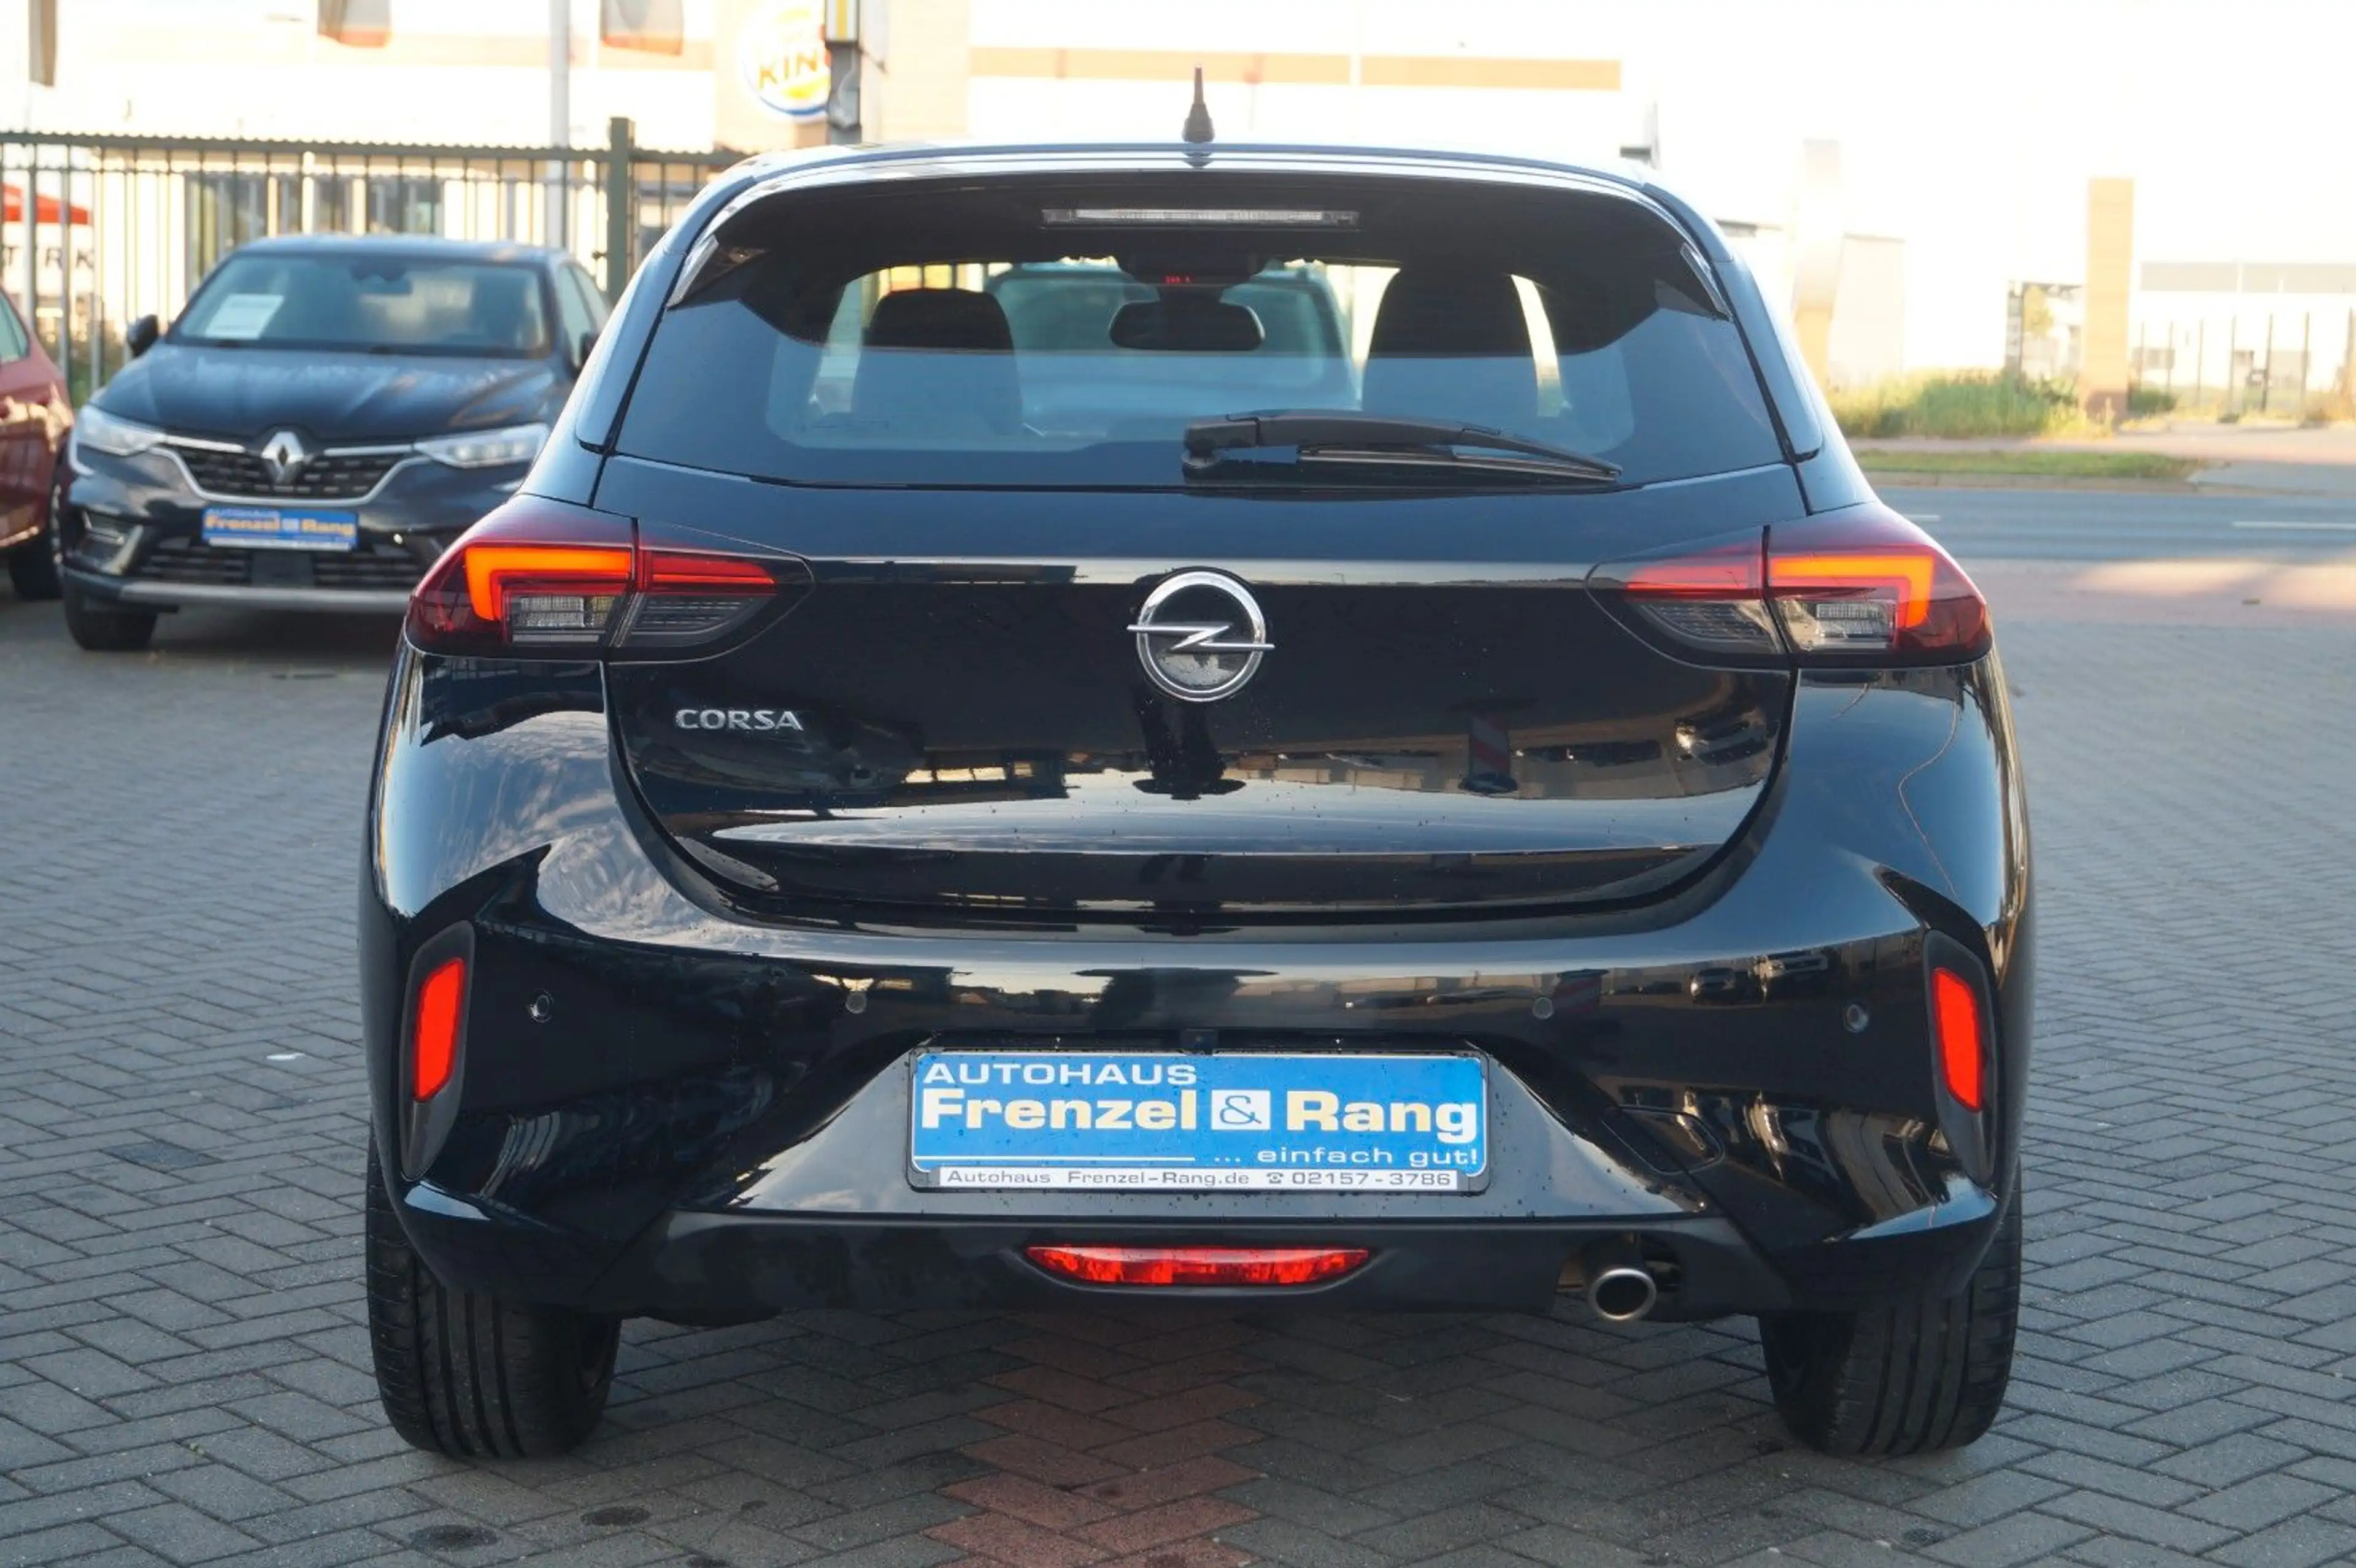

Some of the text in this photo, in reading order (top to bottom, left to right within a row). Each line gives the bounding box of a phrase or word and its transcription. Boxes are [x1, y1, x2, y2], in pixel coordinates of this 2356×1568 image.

[758, 48, 825, 90] KIN
[676, 709, 804, 731] CORSA
[923, 1063, 1197, 1085] AUTOHAUS
[922, 1088, 1477, 1143] Frenzel & Rang
[1257, 1147, 1393, 1164] einfach
[1409, 1148, 1478, 1167] gut!
[947, 1170, 1052, 1184] Autohaus
[1068, 1170, 1250, 1186] Frenzel-Rang.de
